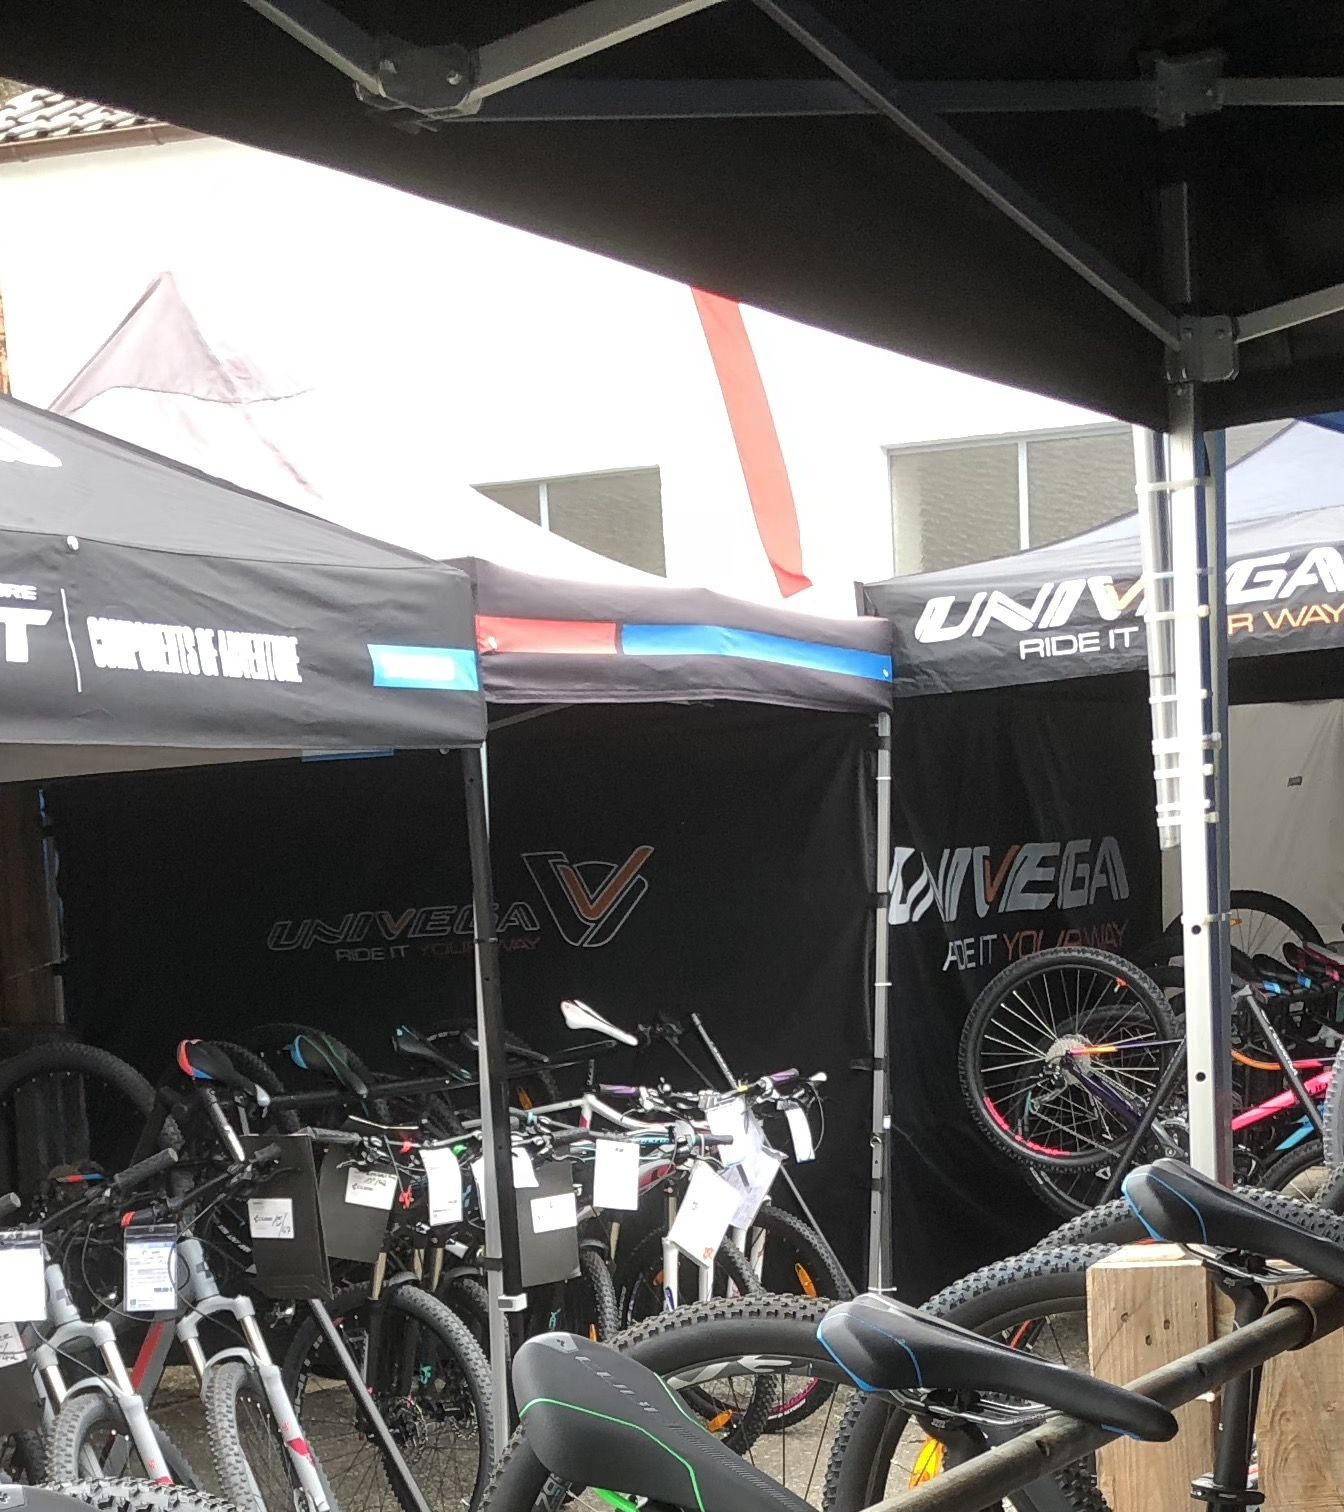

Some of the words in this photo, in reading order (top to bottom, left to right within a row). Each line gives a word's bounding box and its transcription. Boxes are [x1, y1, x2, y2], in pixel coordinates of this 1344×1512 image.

[1019, 631, 1100, 661] RIDE
[1109, 627, 1139, 650] IT
[336, 946, 385, 961] RIDE
[388, 944, 410, 959] IT
[979, 934, 997, 966] IT
